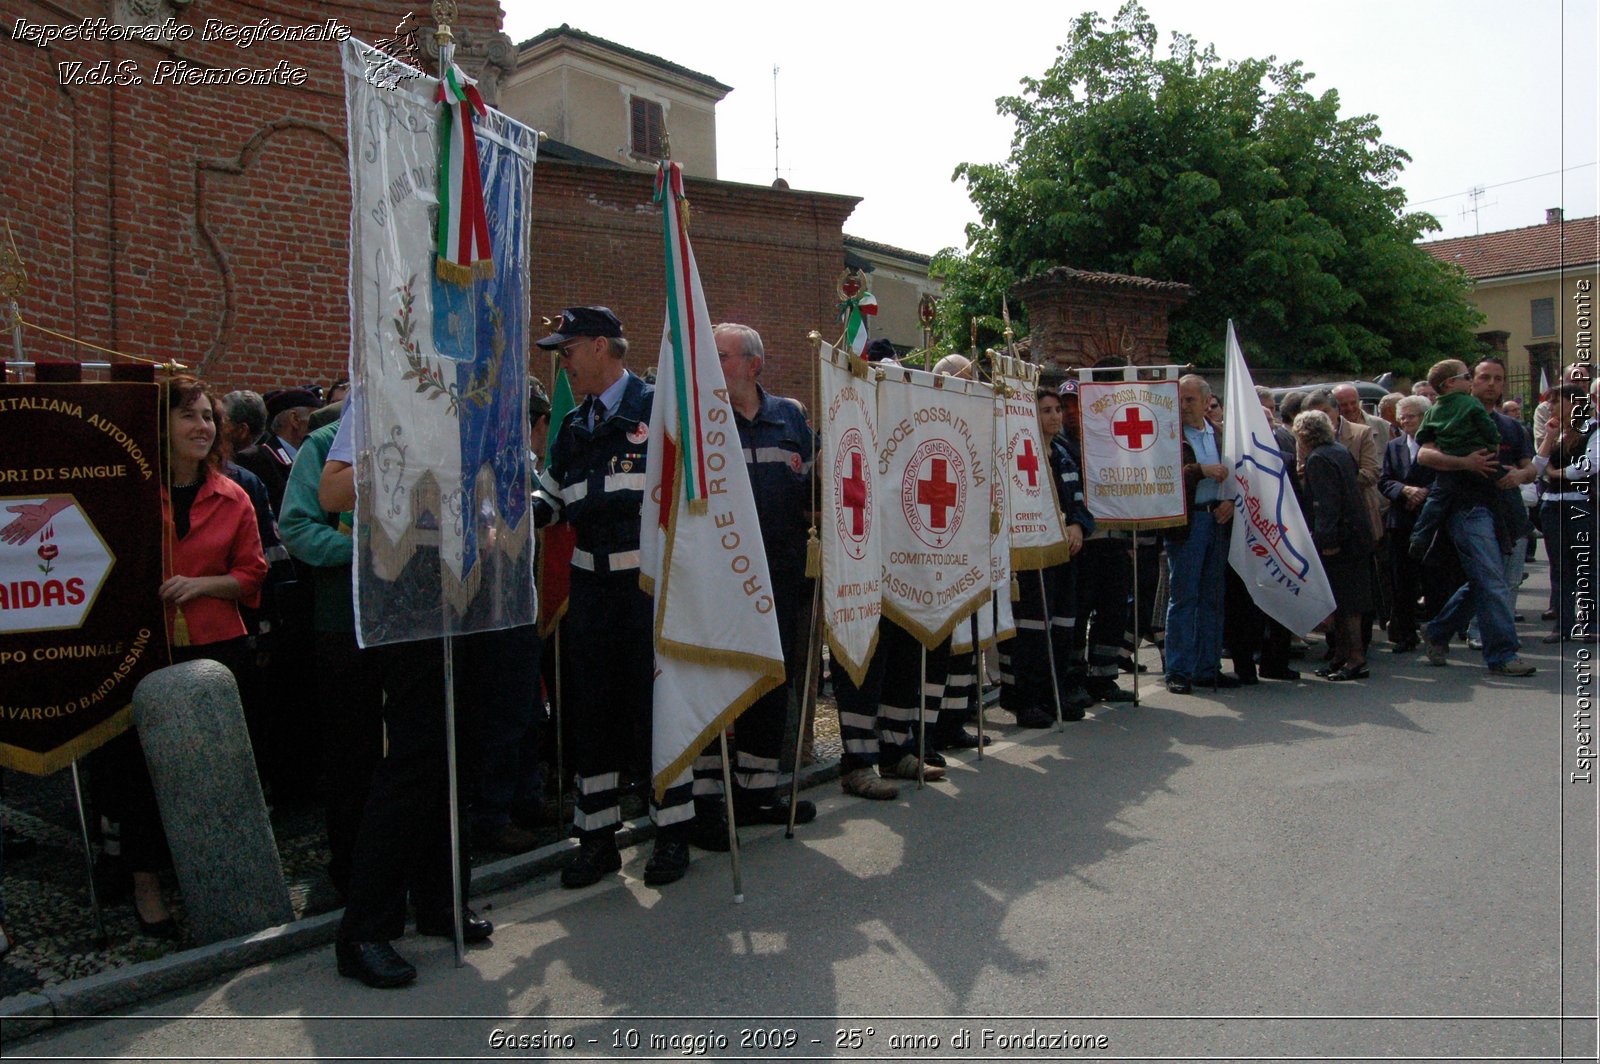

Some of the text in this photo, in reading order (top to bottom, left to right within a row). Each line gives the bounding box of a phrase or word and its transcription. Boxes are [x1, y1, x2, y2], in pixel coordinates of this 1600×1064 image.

[87, 413, 153, 480] AUTONOMA
[878, 418, 914, 476] CROCE
[914, 407, 952, 427] ROSSA
[953, 416, 986, 488] ITALIANA
[33, 468, 55, 481] DI
[59, 464, 127, 479] SANGUE
[1099, 467, 1148, 482] GRUPPO
[706, 387, 773, 614] CROCE ROSSA
[904, 457, 922, 532] CONVENZIONE
[889, 552, 943, 566] COMITATO
[935, 571, 943, 581] DI
[33, 642, 124, 661] COMUNALE
[79, 628, 152, 709] BARDASSANO
